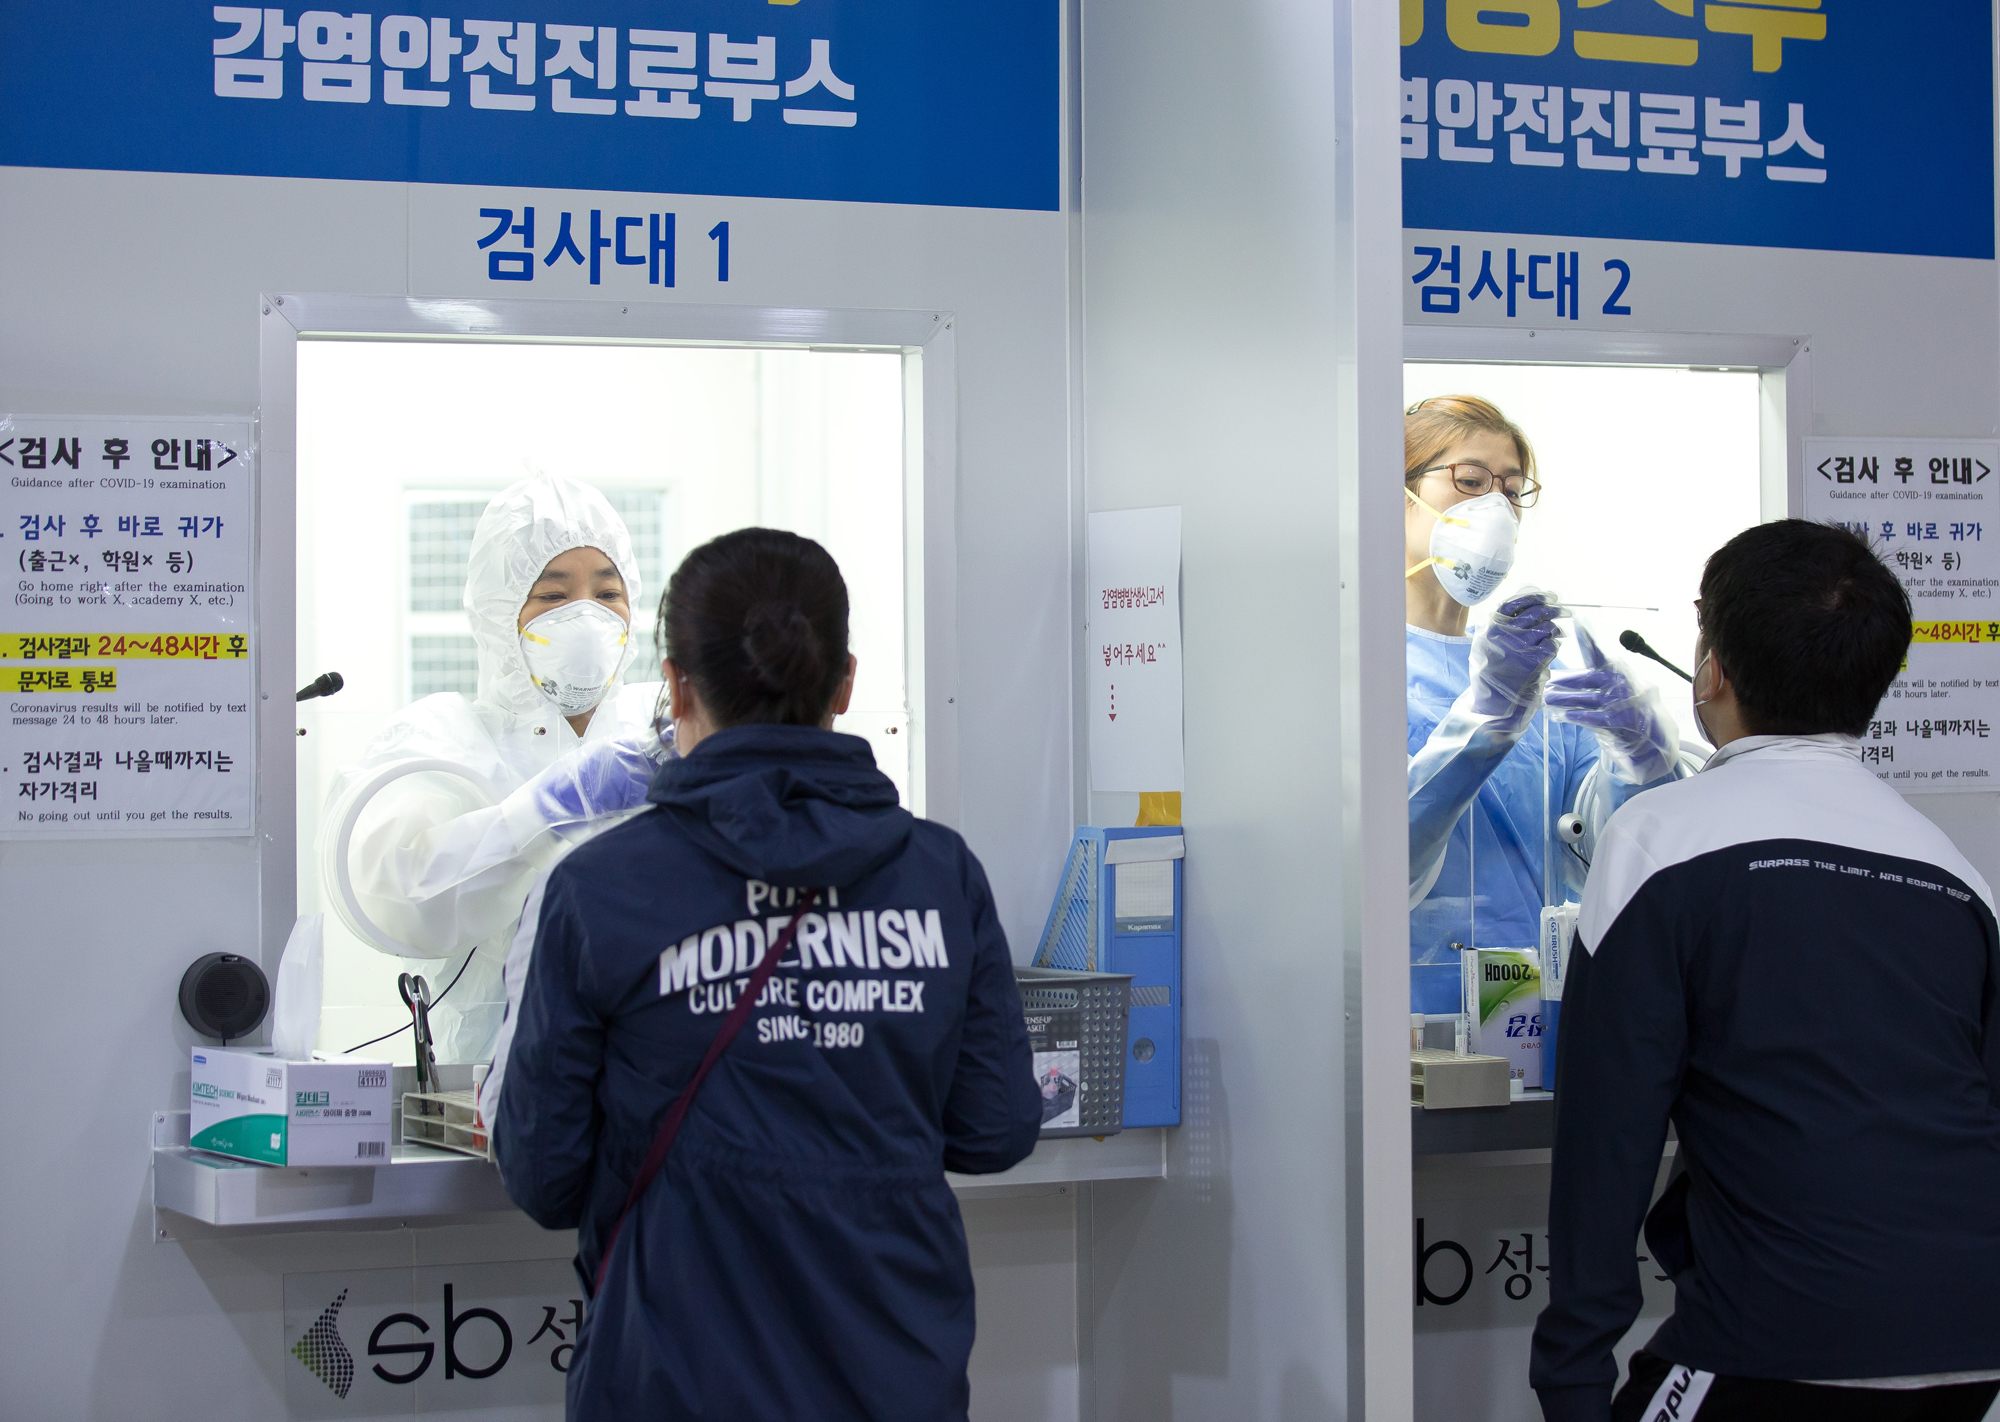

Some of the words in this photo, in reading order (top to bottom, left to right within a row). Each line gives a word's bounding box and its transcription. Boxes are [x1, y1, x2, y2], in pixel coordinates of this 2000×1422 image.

[213, 6, 857, 127] 감염안전진료부스
[477, 206, 675, 287] 검사대
[708, 221, 730, 281] 1
[1411, 246, 1579, 320] 검사대
[1602, 259, 1632, 316] 2
[102, 438, 130, 469] 후
[1894, 457, 1914, 484] 후
[11, 477, 63, 488] Guidance
[68, 478, 95, 488] after
[100, 478, 154, 488] COVID-19
[159, 479, 226, 489] examination
[1829, 490, 1866, 499] Guidance
[1870, 490, 1889, 499] after
[1893, 491, 1932, 500] COVID-19
[1935, 491, 1983, 500] examination
[19, 514, 66, 540] 검사
[80, 514, 103, 538] 후
[118, 515, 163, 537] 바로
[178, 515, 224, 538] 귀가
[1880, 521, 1896, 541] 후
[1907, 522, 1939, 541] 바로
[1949, 522, 1982, 541] 귀가
[166, 551, 194, 573] 등)
[1941, 551, 1961, 571] 등)
[19, 581, 35, 592] Go
[40, 581, 74, 592] home
[79, 581, 109, 594] right
[114, 581, 143, 592] after
[148, 581, 168, 592] the
[173, 581, 245, 593] examination
[1905, 577, 1926, 587] after
[1930, 577, 1943, 586] the
[1947, 577, 1999, 587] examination
[15, 594, 54, 606] (Going
[59, 595, 72, 605] to
[78, 594, 106, 605] work
[113, 595, 125, 606] X,
[131, 594, 184, 607] academy
[190, 595, 202, 606] X,
[208, 594, 234, 607] etc.)
[1102, 585, 1164, 609] 감염병발생신고서
[1917, 588, 1955, 599] academy
[1959, 588, 1968, 598] X,
[1972, 588, 1992, 599] etc.)
[1986, 622, 2000, 641] 후
[19, 637, 91, 659] 검사결과
[226, 635, 248, 657] 후
[18, 670, 72, 692] 문자로
[79, 670, 117, 693] 통보
[1889, 679, 1908, 688] sults
[1911, 680, 1924, 688] will
[1928, 680, 1937, 688] be
[1940, 680, 1969, 688] notified
[1973, 680, 1982, 690] by
[1985, 679, 1999, 688] text
[1892, 690, 1902, 699] 48
[1905, 690, 1928, 699] hours
[1931, 690, 1950, 699] later.
[10, 703, 77, 713] Coronavirus
[82, 703, 118, 713] results
[123, 703, 141, 713] will
[146, 703, 159, 713] be
[164, 703, 204, 713] notified
[209, 703, 222, 715] by
[227, 703, 247, 713] text
[12, 716, 58, 727] message
[63, 715, 76, 725] 24
[80, 716, 91, 725] to
[96, 715, 109, 725] 48
[114, 715, 146, 725] hours
[150, 715, 178, 725] later.
[1906, 719, 1991, 739] 나올때까지는
[23, 751, 103, 773] 검사결과
[115, 750, 234, 773] 나올때까지는
[1877, 771, 1889, 779] out
[1893, 770, 1910, 779] until
[1914, 771, 1928, 780] you
[1931, 770, 1943, 779] get
[1946, 769, 1959, 778] the
[1962, 769, 1990, 778] results.
[18, 781, 98, 803] 자가격리
[18, 811, 34, 821] No
[39, 811, 68, 822] going
[73, 811, 91, 820] out
[97, 810, 120, 820] until
[126, 811, 145, 822] you
[150, 811, 167, 822] get
[171, 810, 189, 819] the
[193, 809, 233, 820] results.
[1749, 858, 1810, 871] SURPASS
[1814, 860, 1836, 871] THE
[1840, 865, 1875, 879] LIMIT.
[659, 909, 949, 997] MODERNISM
[806, 979, 925, 1013] COMPLEX
[757, 1015, 811, 1043] SINC
[813, 1022, 864, 1048] 1980
[1026, 1024, 1046, 1033] ASKET
[193, 1081, 218, 1095] KIMTECH
[360, 1077, 384, 1086] 41117
[296, 1091, 329, 1102] 킴테크
[368, 1283, 513, 1384] sb
